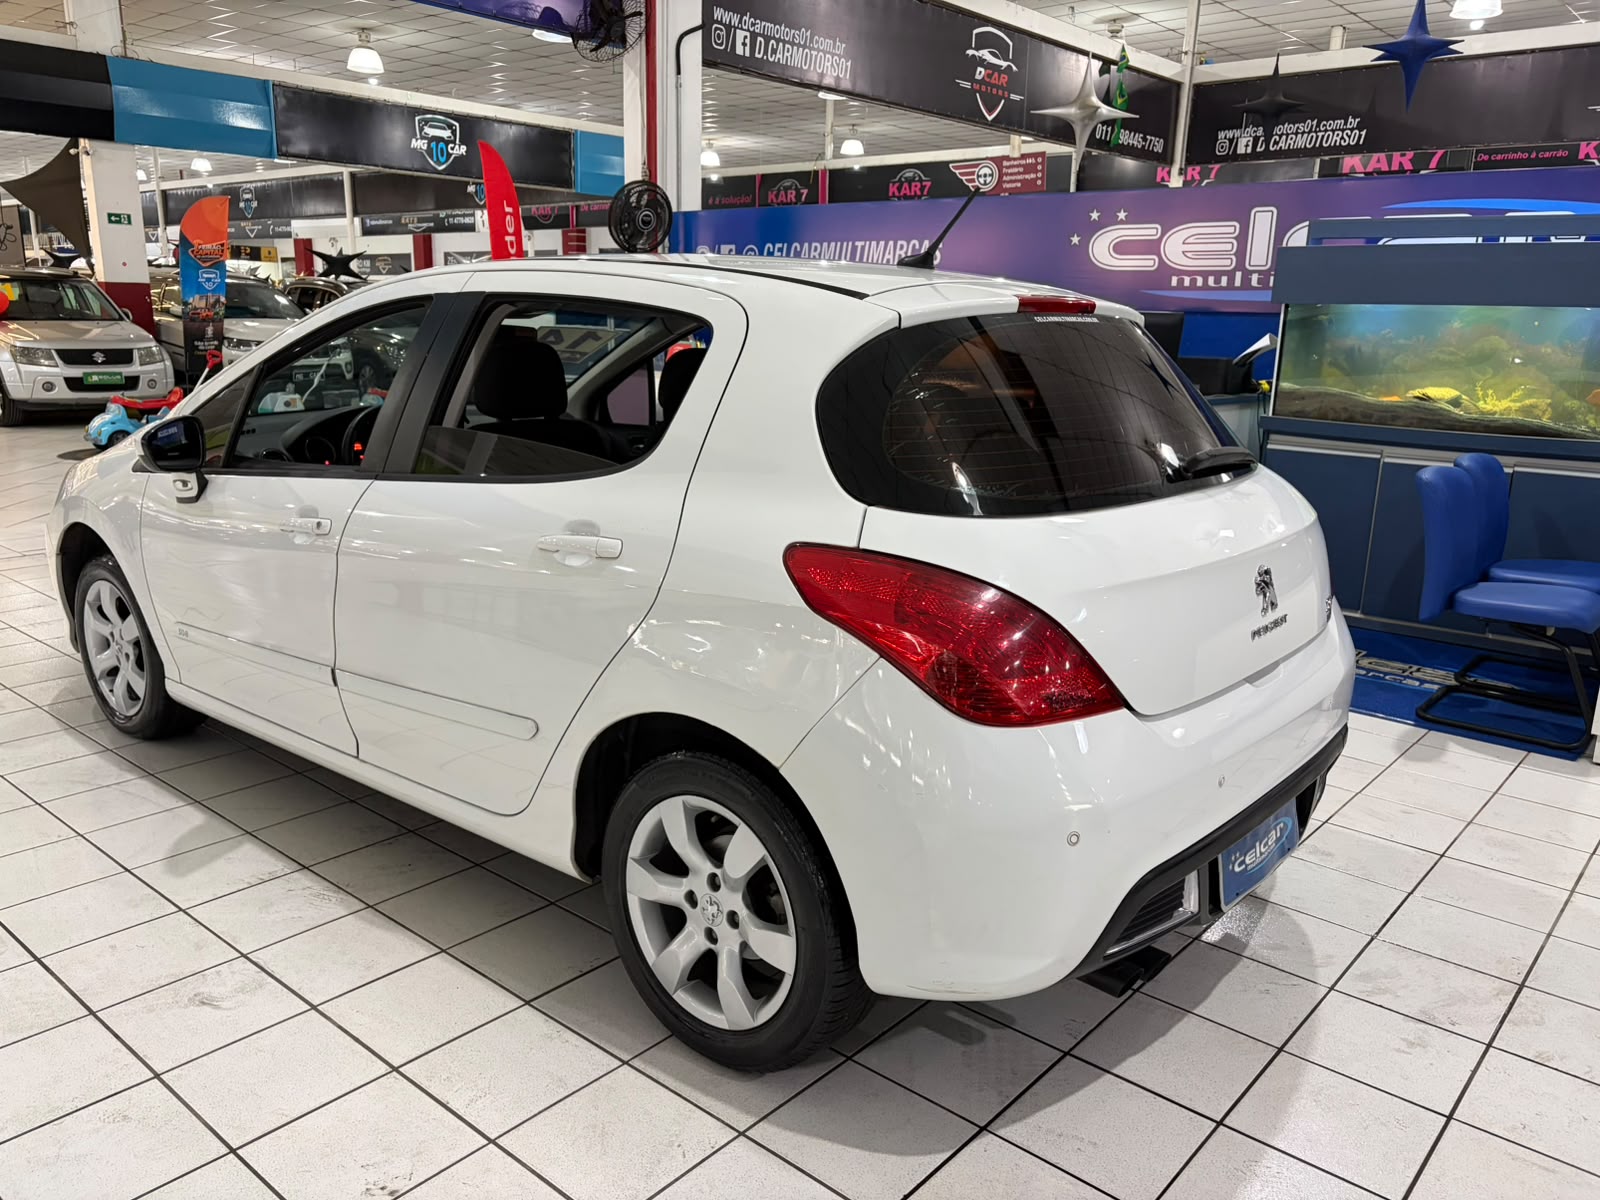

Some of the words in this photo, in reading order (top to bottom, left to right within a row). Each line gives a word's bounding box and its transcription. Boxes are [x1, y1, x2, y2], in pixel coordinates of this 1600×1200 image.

[713, 5, 846, 56] www.dcarmotors01.com.br
[755, 36, 852, 80] D.CARMOTORS01
[974, 66, 1009, 88] DCAR
[972, 82, 1009, 98] MOTORS
[1095, 123, 1112, 141] 011
[1118, 128, 1164, 153] 98445-7750
[1218, 115, 1361, 140] www.dcaotors01.com.br
[410, 138, 428, 150] MG
[431, 140, 447, 164] 10
[447, 143, 467, 155] CAR
[1256, 129, 1367, 153] DCARMOTORS01
[1341, 151, 1415, 174] KAR
[1428, 150, 1446, 169] 7
[1477, 153, 1489, 162] De
[1491, 151, 1528, 161] carrinho
[1538, 149, 1569, 159] carrão
[1156, 165, 1201, 182] KR
[1208, 164, 1222, 180] 7
[768, 190, 797, 203] KAR
[800, 189, 809, 202] 7
[504, 199, 517, 256] der
[1234, 821, 1284, 873] celcar
